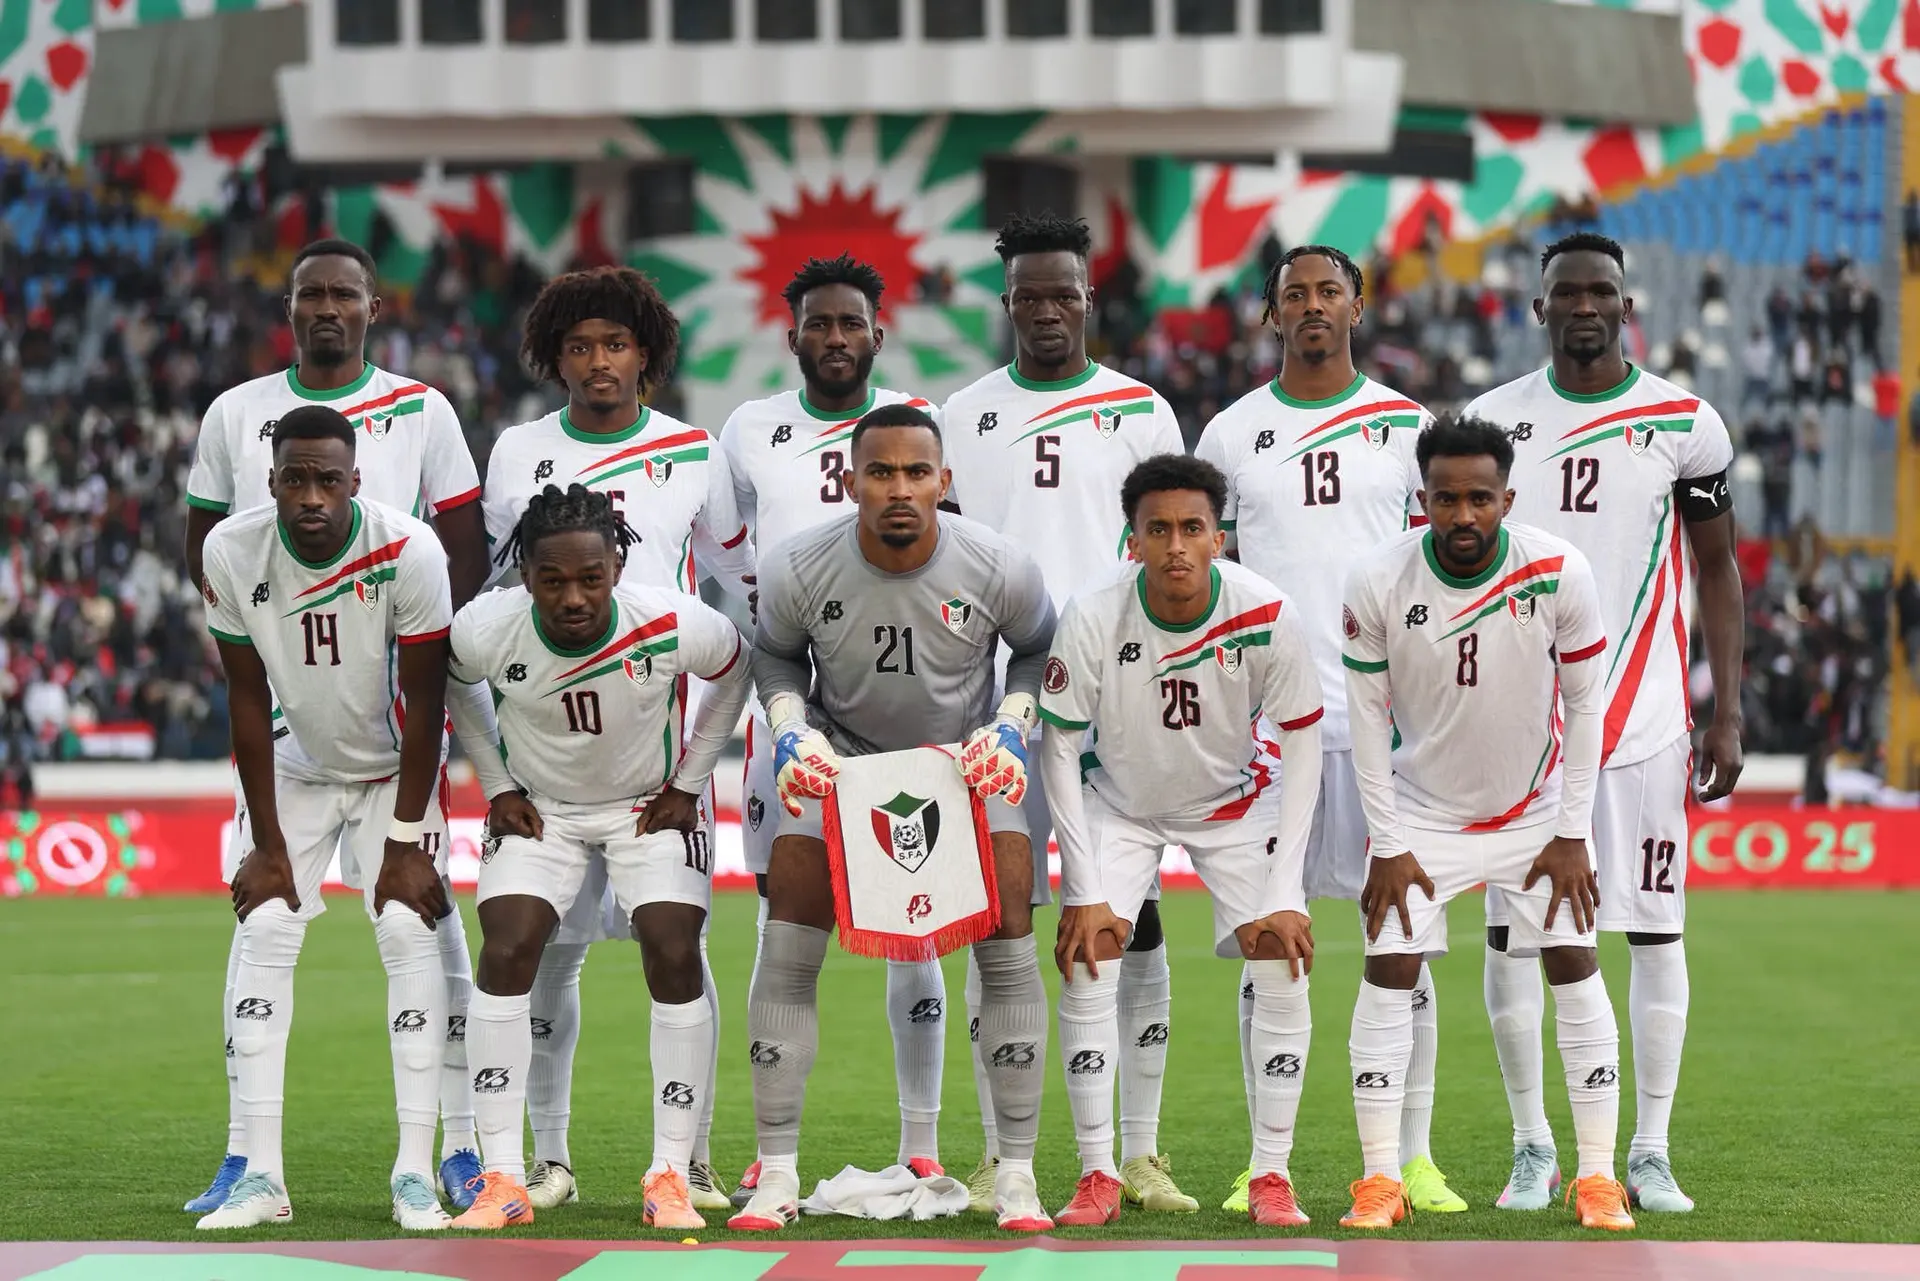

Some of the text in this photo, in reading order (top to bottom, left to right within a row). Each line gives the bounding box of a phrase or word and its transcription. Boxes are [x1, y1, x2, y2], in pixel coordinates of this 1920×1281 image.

[820, 451, 844, 504] 3
[1034, 435, 1060, 488] 5
[1301, 451, 1341, 506] 13
[1560, 457, 1600, 512] 12
[300, 611, 342, 666] 14
[873, 625, 917, 676] 21
[1456, 632, 1478, 687] 8
[561, 690, 602, 736] 10
[1160, 678, 1201, 730] 26
[1640, 838, 1676, 893] 12
[1802, 820, 1876, 874] 25
